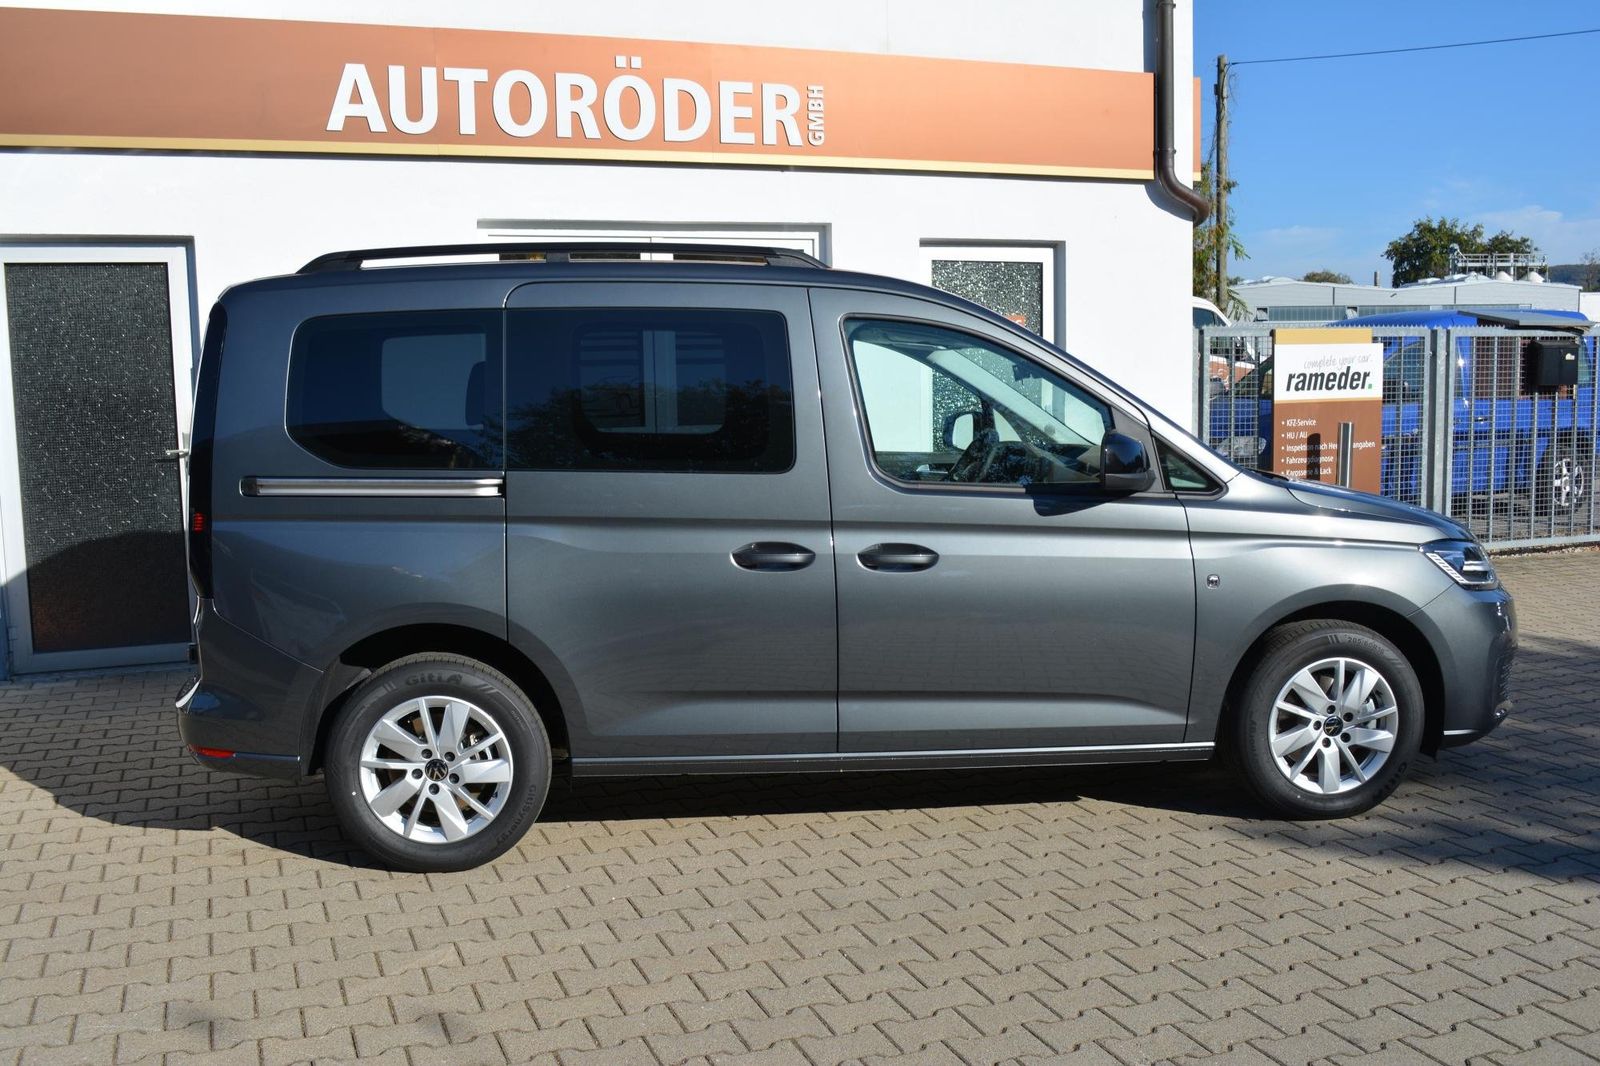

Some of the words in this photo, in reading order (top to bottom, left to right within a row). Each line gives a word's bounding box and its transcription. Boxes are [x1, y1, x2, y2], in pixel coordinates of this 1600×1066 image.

[325, 55, 803, 147] AUTORÖDER
[807, 85, 825, 147] GMBH
[1286, 418, 1317, 428] KFZ-Service
[1286, 431, 1295, 440] HU
